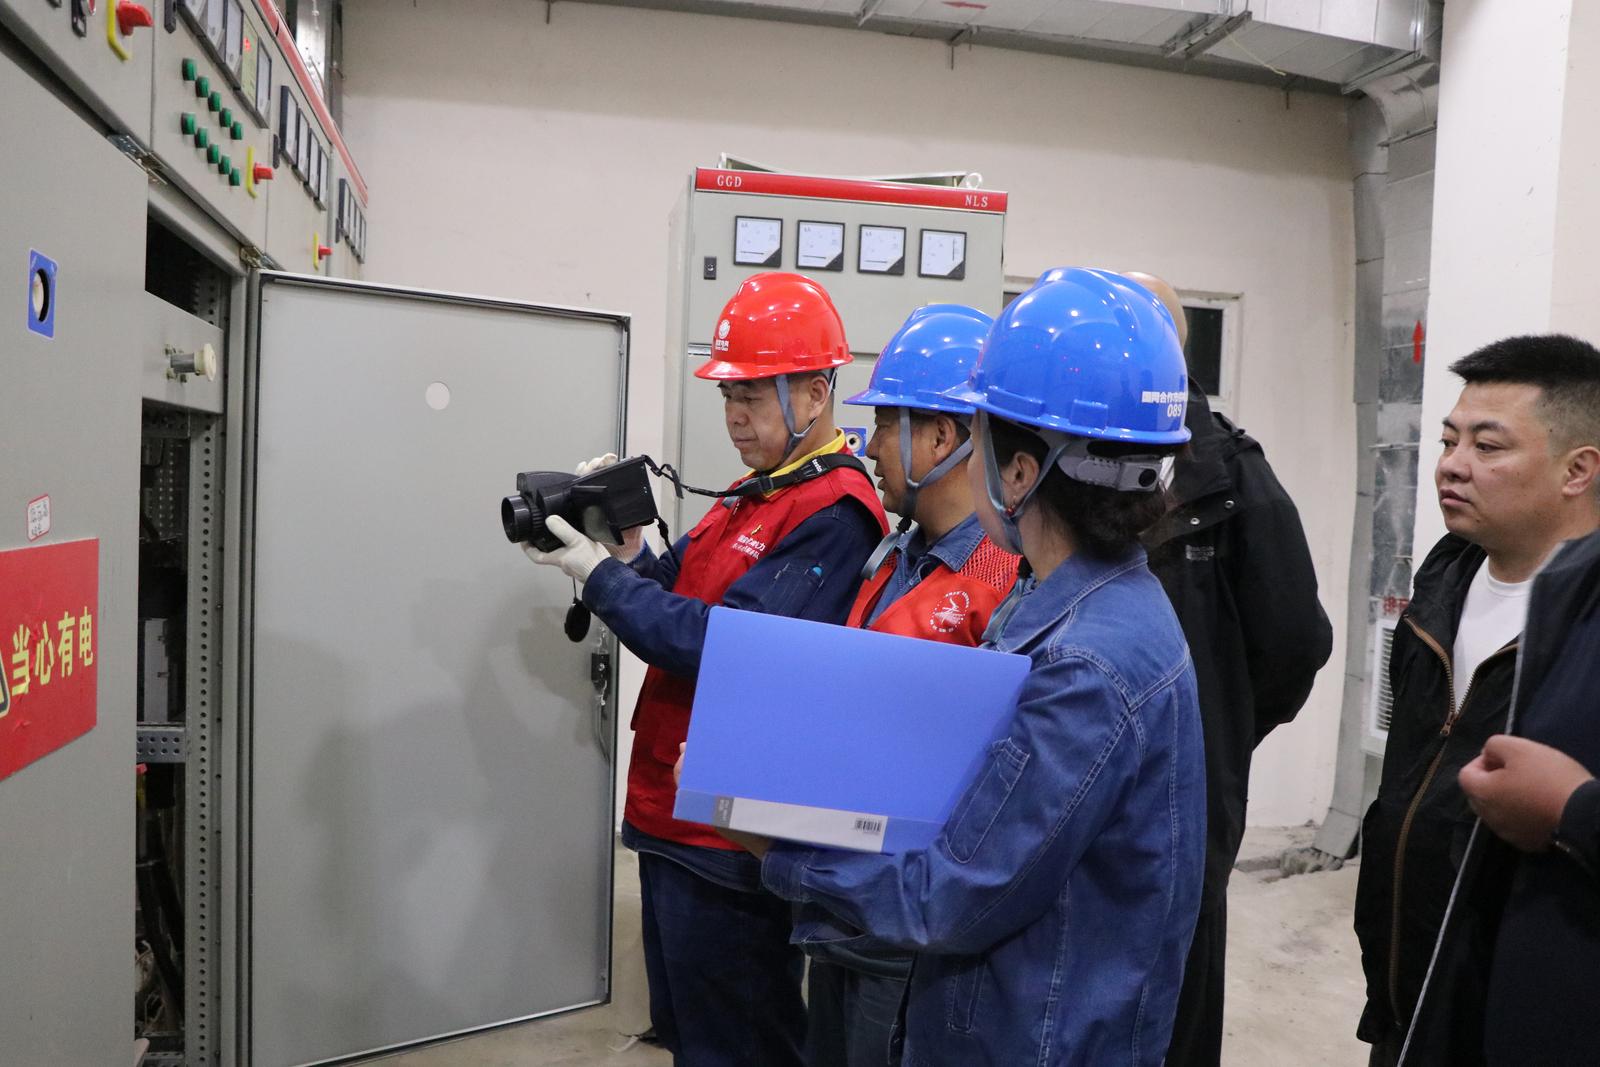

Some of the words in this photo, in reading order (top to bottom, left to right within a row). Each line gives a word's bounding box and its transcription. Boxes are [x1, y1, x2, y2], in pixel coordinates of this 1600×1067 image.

[717, 174, 742, 188] GGD
[965, 194, 988, 208] NLS
[11, 606, 94, 696] 当心有电
